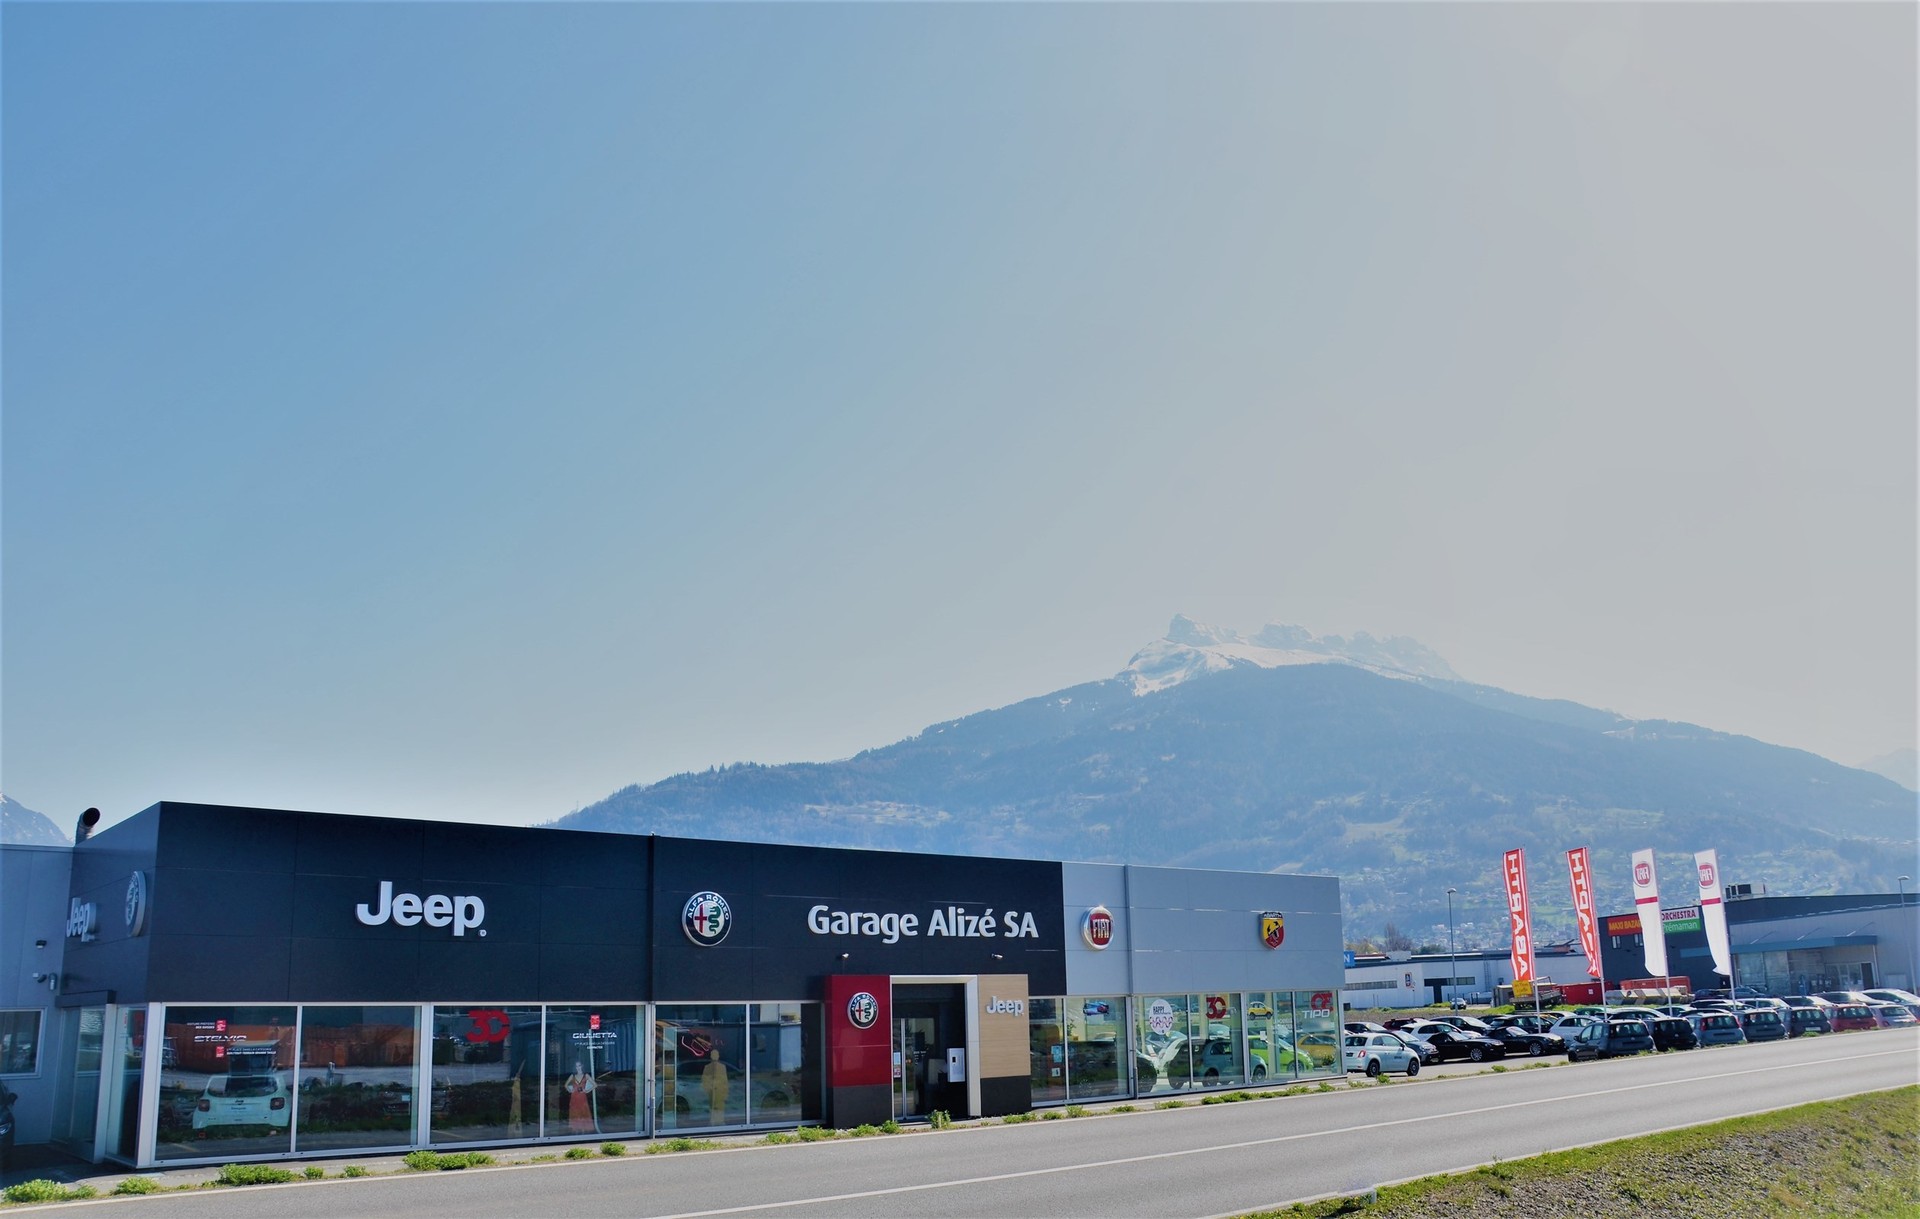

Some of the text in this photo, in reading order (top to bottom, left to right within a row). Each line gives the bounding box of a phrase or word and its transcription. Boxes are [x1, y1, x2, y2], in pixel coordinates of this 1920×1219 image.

[355, 880, 486, 937] Jeep
[687, 894, 730, 921] ALFA ROMEO
[1661, 909, 1696, 921] ORCHESTRA
[66, 897, 93, 943] Jeep
[807, 904, 1040, 944] Garage Alizé SA
[1092, 918, 1110, 939] FIAT
[986, 995, 1024, 1017] Jeep
[1302, 1009, 1330, 1019] TIPO
